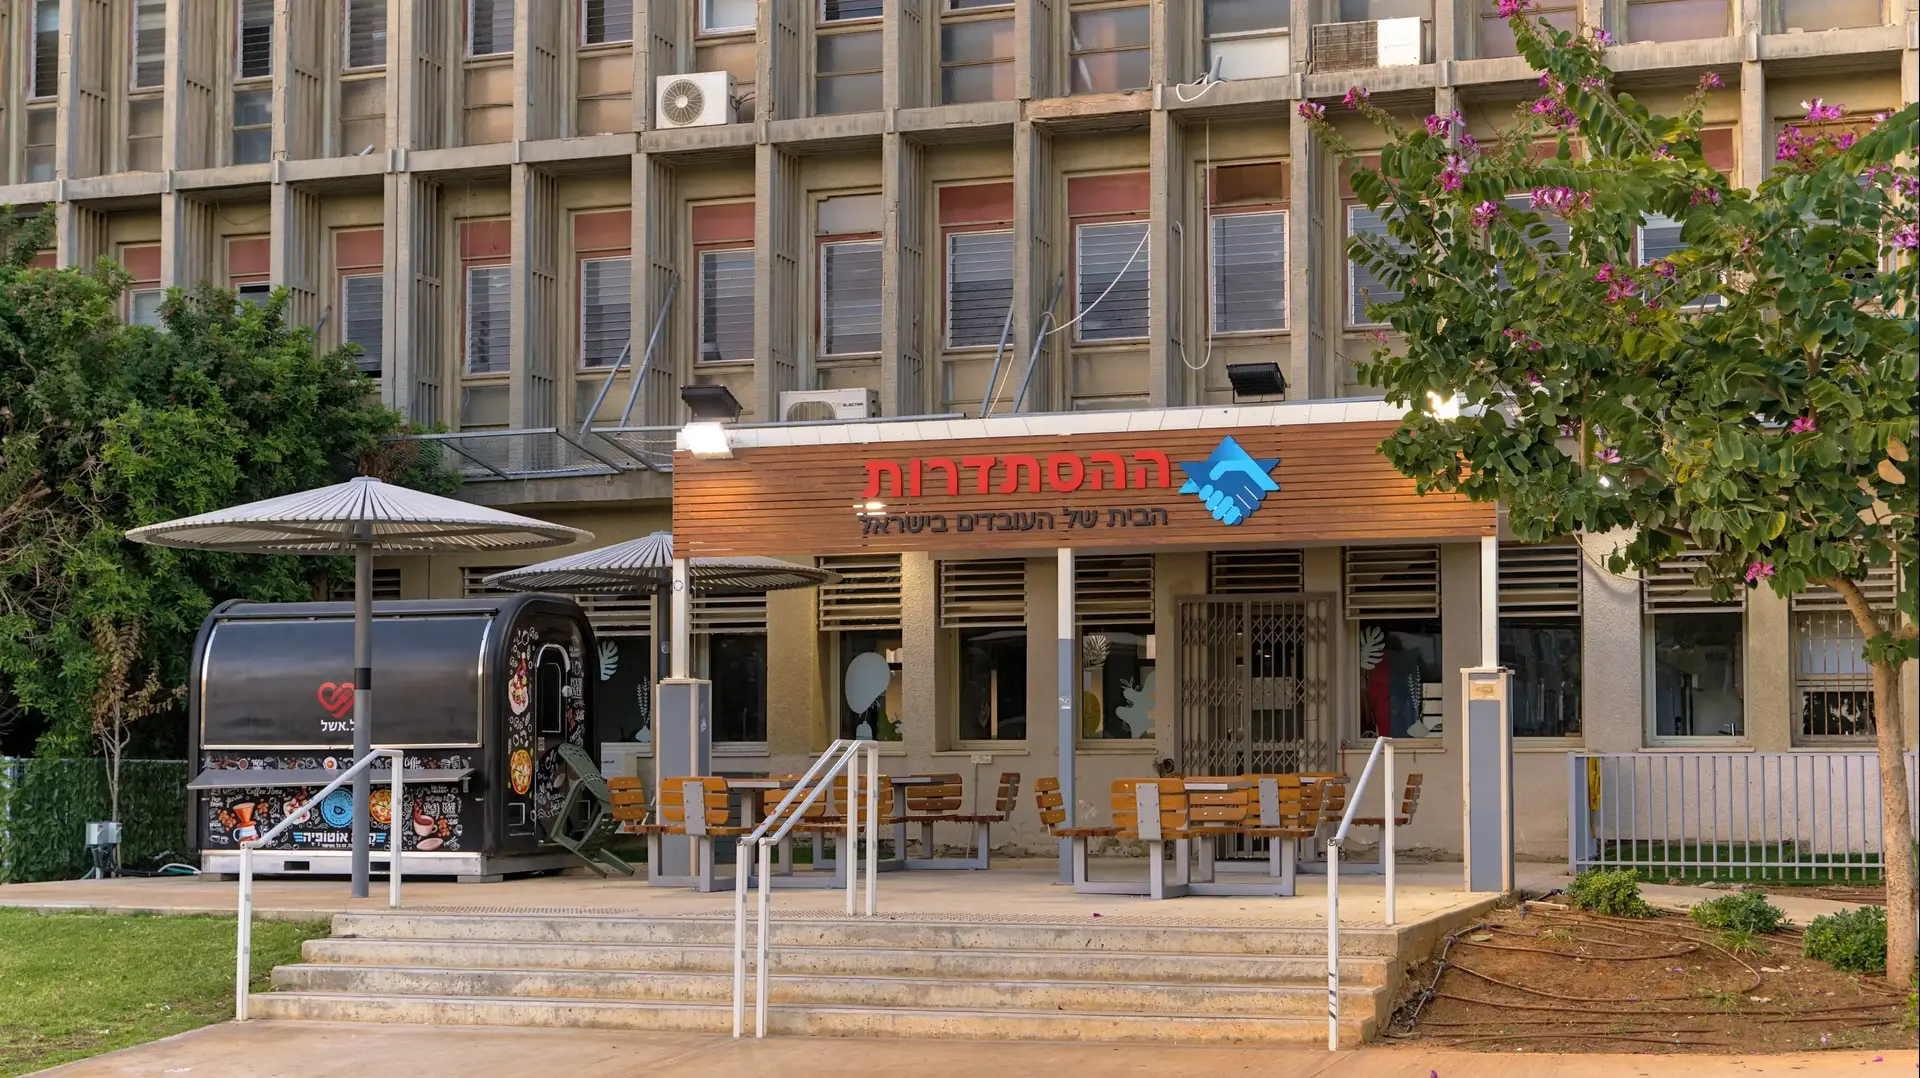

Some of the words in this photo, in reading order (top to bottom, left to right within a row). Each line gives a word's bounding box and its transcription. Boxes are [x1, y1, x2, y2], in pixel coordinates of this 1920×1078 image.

[862, 449, 1171, 499] ההסתדרות
[858, 512, 949, 535] בישראל
[956, 509, 1055, 532] העובדים
[1063, 507, 1099, 530] של
[1108, 506, 1169, 530] הבית
